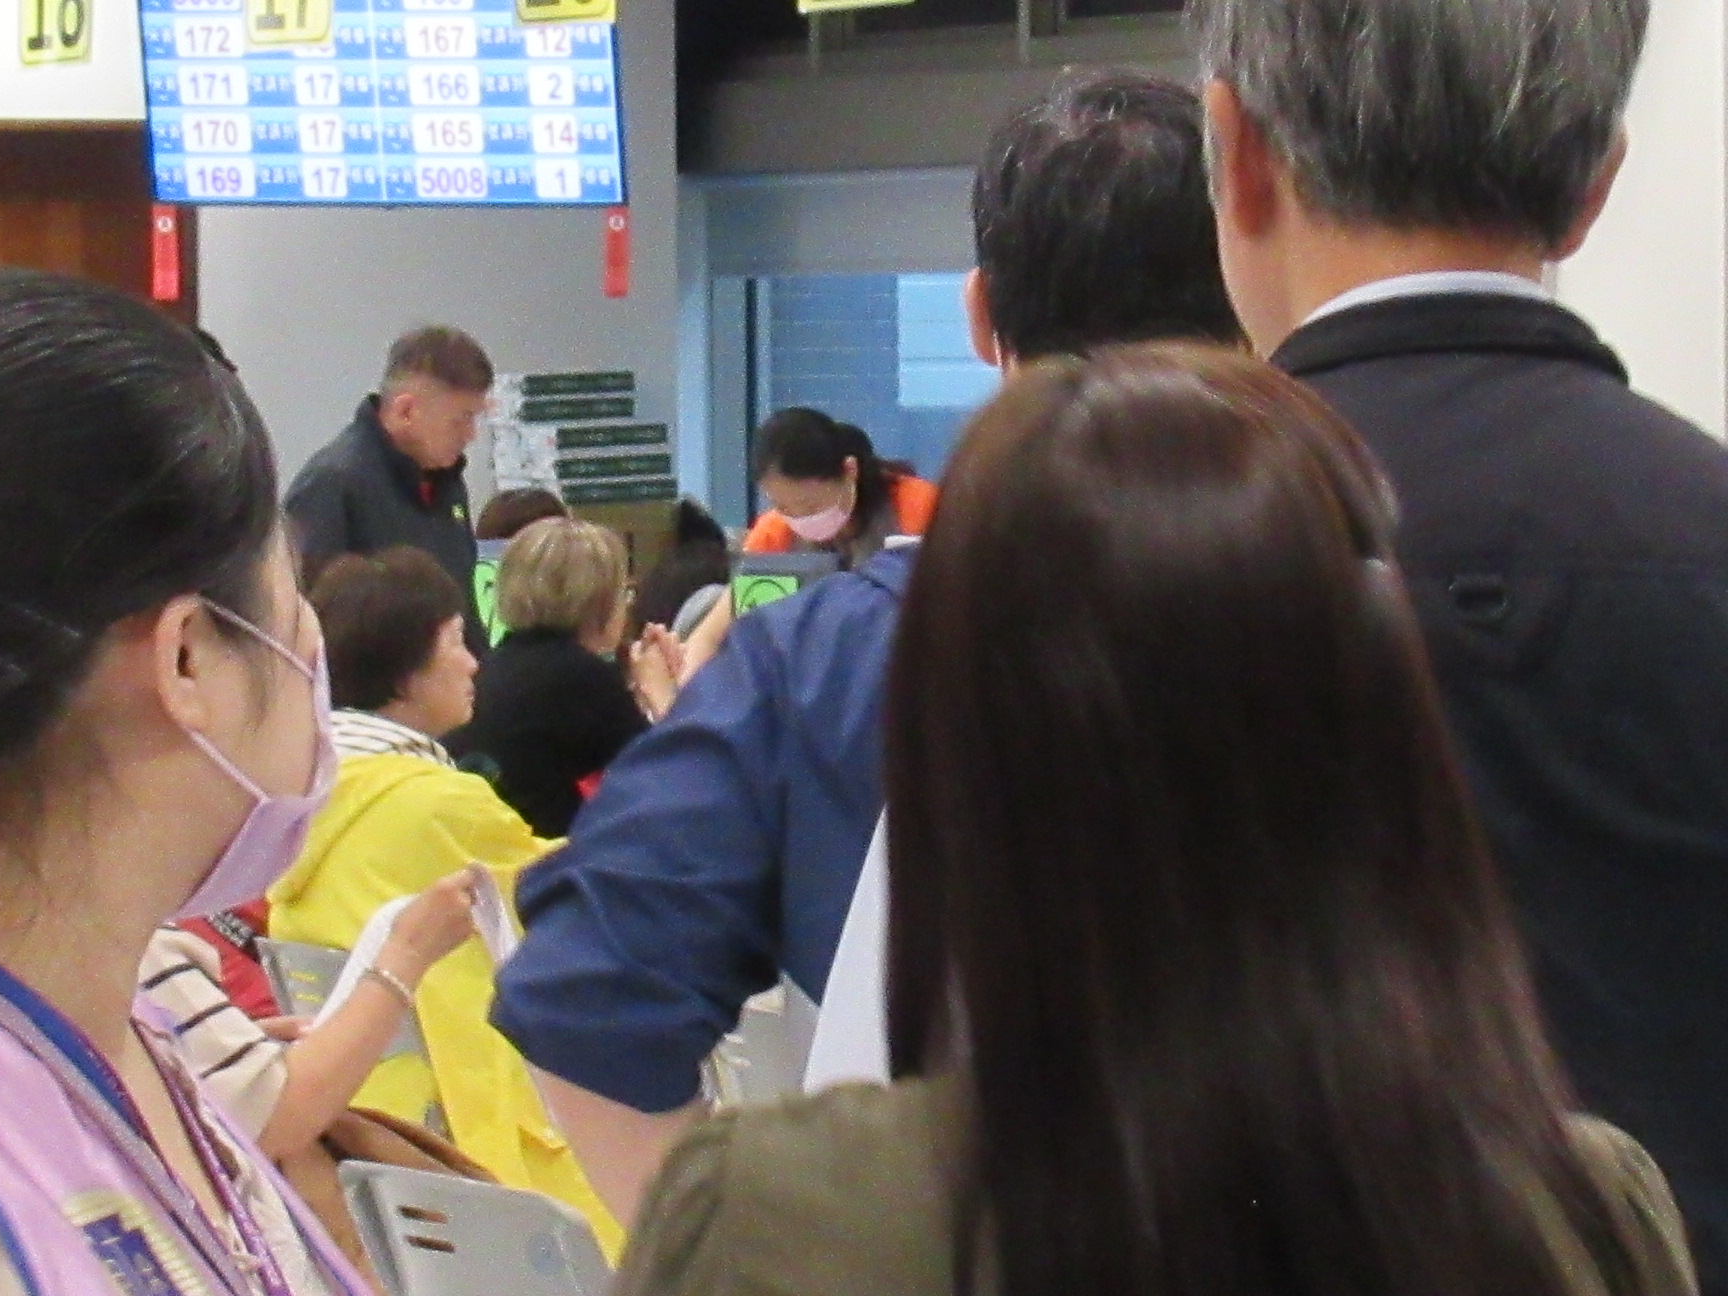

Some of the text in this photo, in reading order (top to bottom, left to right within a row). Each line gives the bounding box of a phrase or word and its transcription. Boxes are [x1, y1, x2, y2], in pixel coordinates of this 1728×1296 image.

[185, 25, 230, 53] 172
[419, 25, 465, 54] 167
[536, 24, 567, 53] 12
[189, 73, 233, 100] 171
[305, 73, 334, 100] 17
[423, 73, 470, 100] 166
[547, 73, 563, 100] 2
[193, 120, 238, 147] 170
[309, 120, 337, 147] 17
[425, 120, 473, 147] 165
[544, 120, 575, 147] 14
[196, 166, 242, 193] 169
[313, 167, 341, 194] 17
[421, 167, 484, 194] 5008
